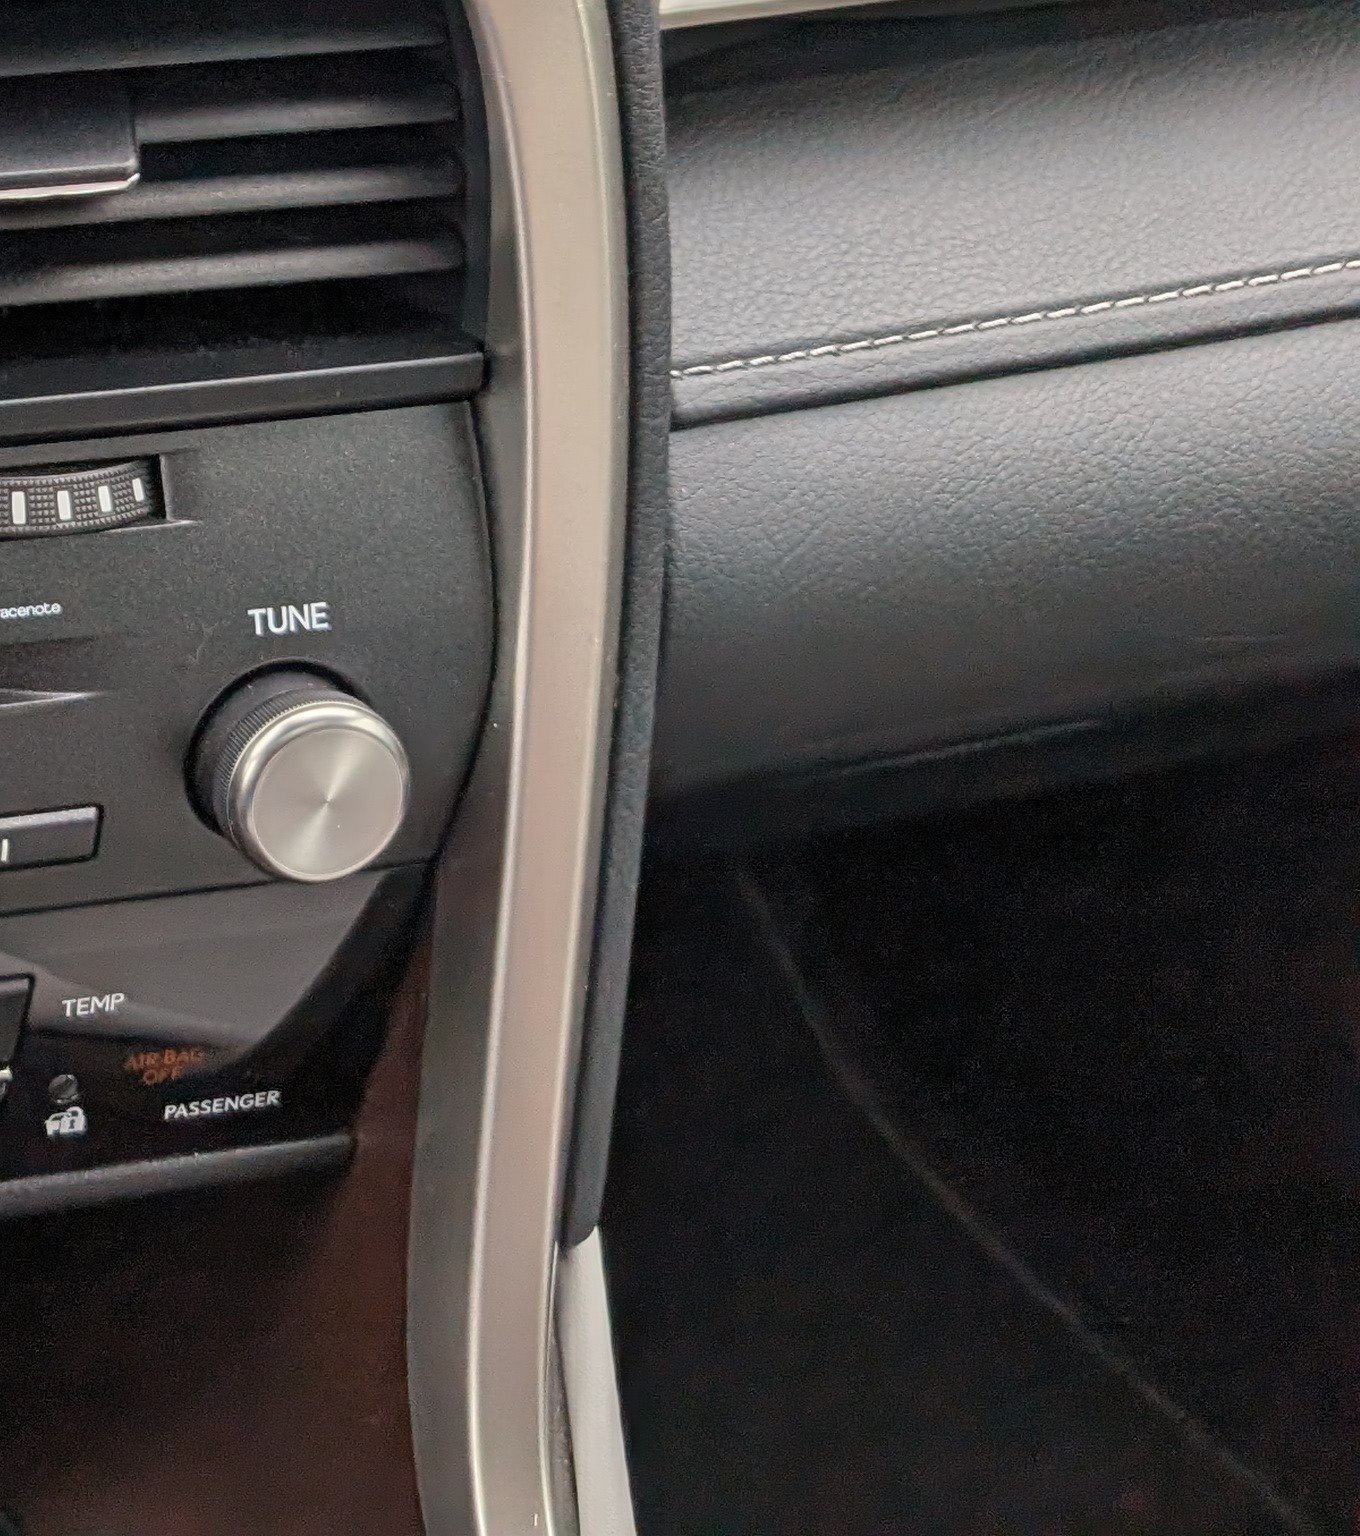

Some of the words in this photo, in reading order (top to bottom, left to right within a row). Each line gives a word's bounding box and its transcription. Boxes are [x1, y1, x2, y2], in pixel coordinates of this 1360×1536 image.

[247, 601, 331, 636] TUNE
[61, 992, 126, 1018] TEMP
[163, 1089, 282, 1122] PASSENGER
